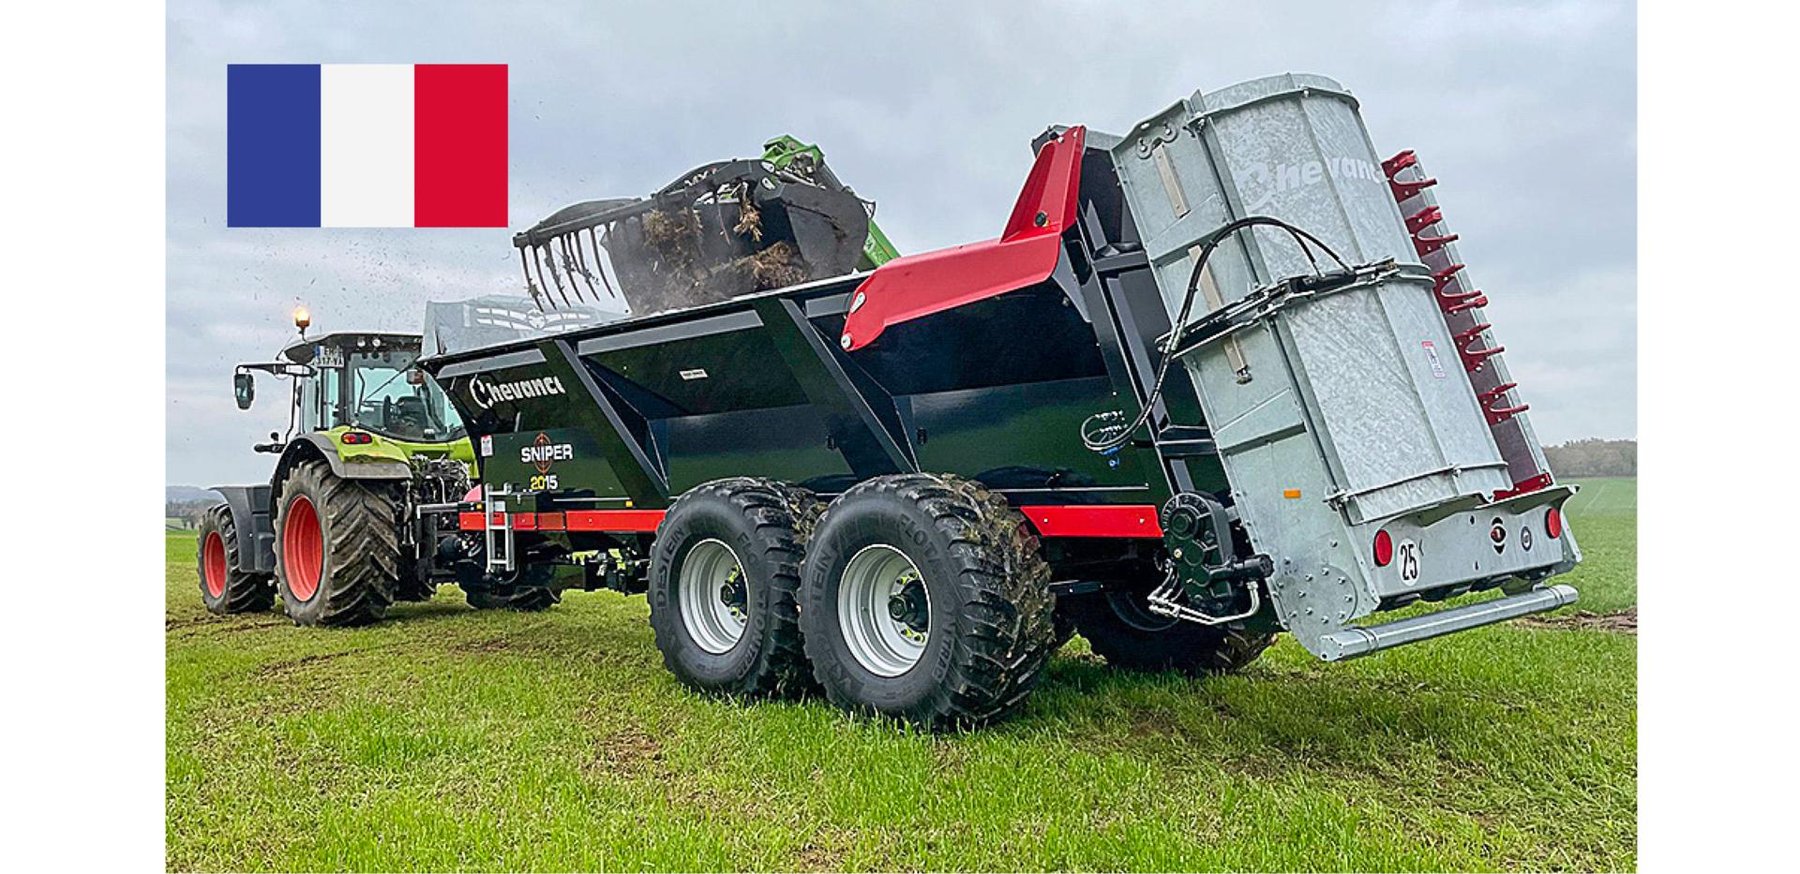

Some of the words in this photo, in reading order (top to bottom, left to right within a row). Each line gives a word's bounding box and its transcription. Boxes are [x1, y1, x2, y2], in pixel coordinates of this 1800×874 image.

[521, 443, 573, 463] SNIPER
[530, 475, 559, 490] 2015
[1400, 543, 1419, 581] 25
